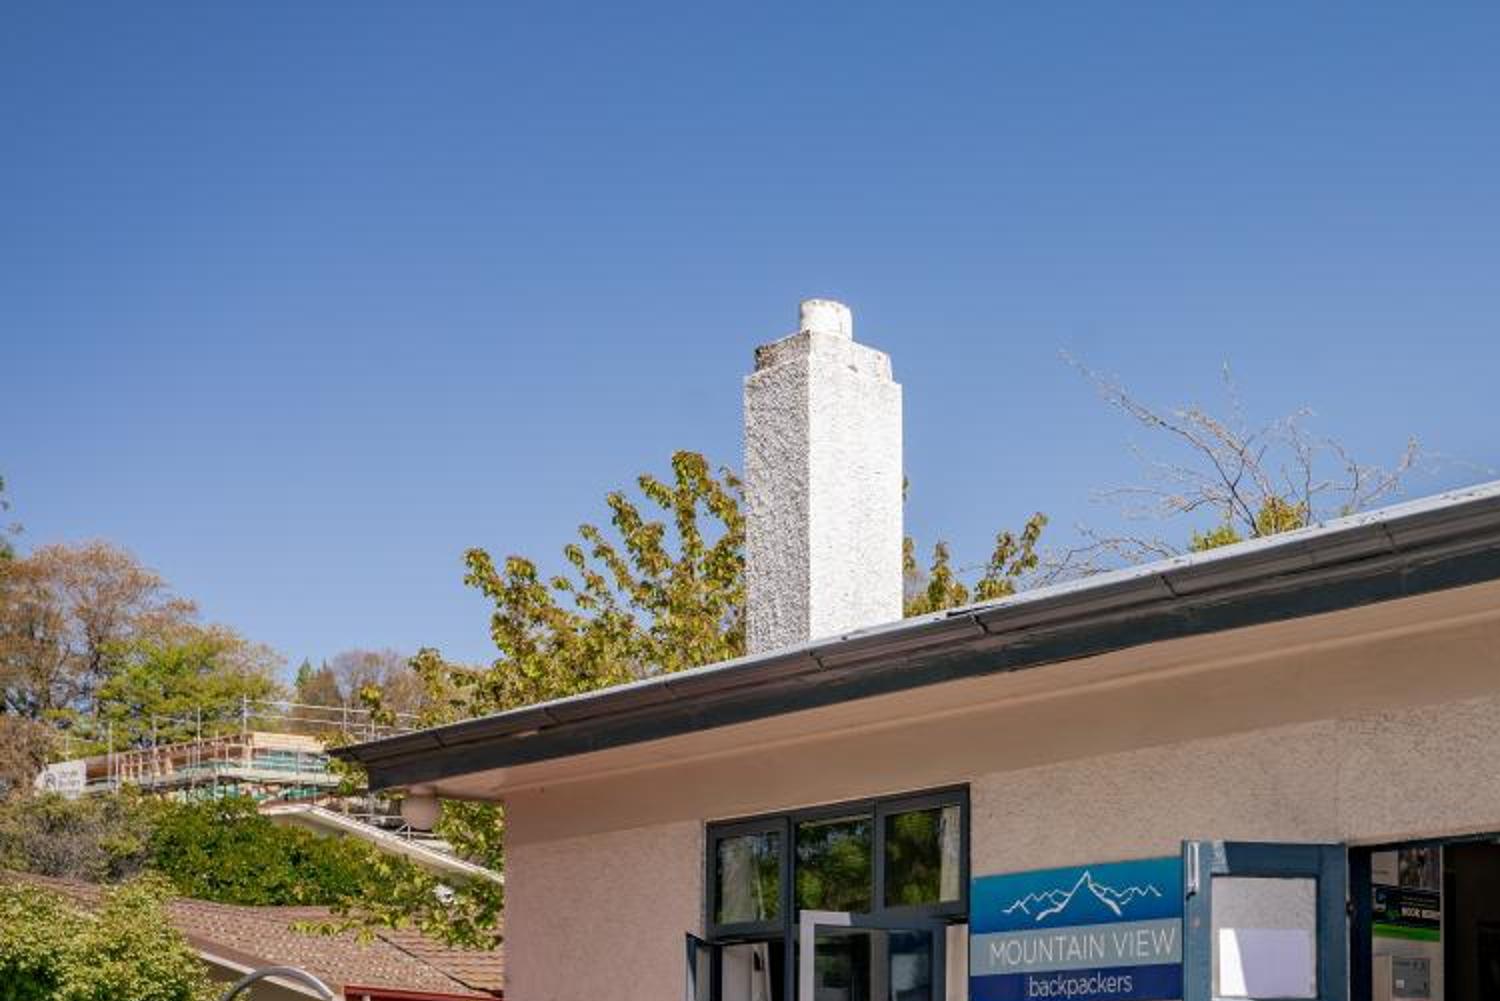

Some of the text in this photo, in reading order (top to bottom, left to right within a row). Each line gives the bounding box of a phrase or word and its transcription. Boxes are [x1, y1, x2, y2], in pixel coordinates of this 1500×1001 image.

[989, 927, 1176, 966] MOUNTAIN VIEW
[1028, 972, 1133, 999] backpackers
